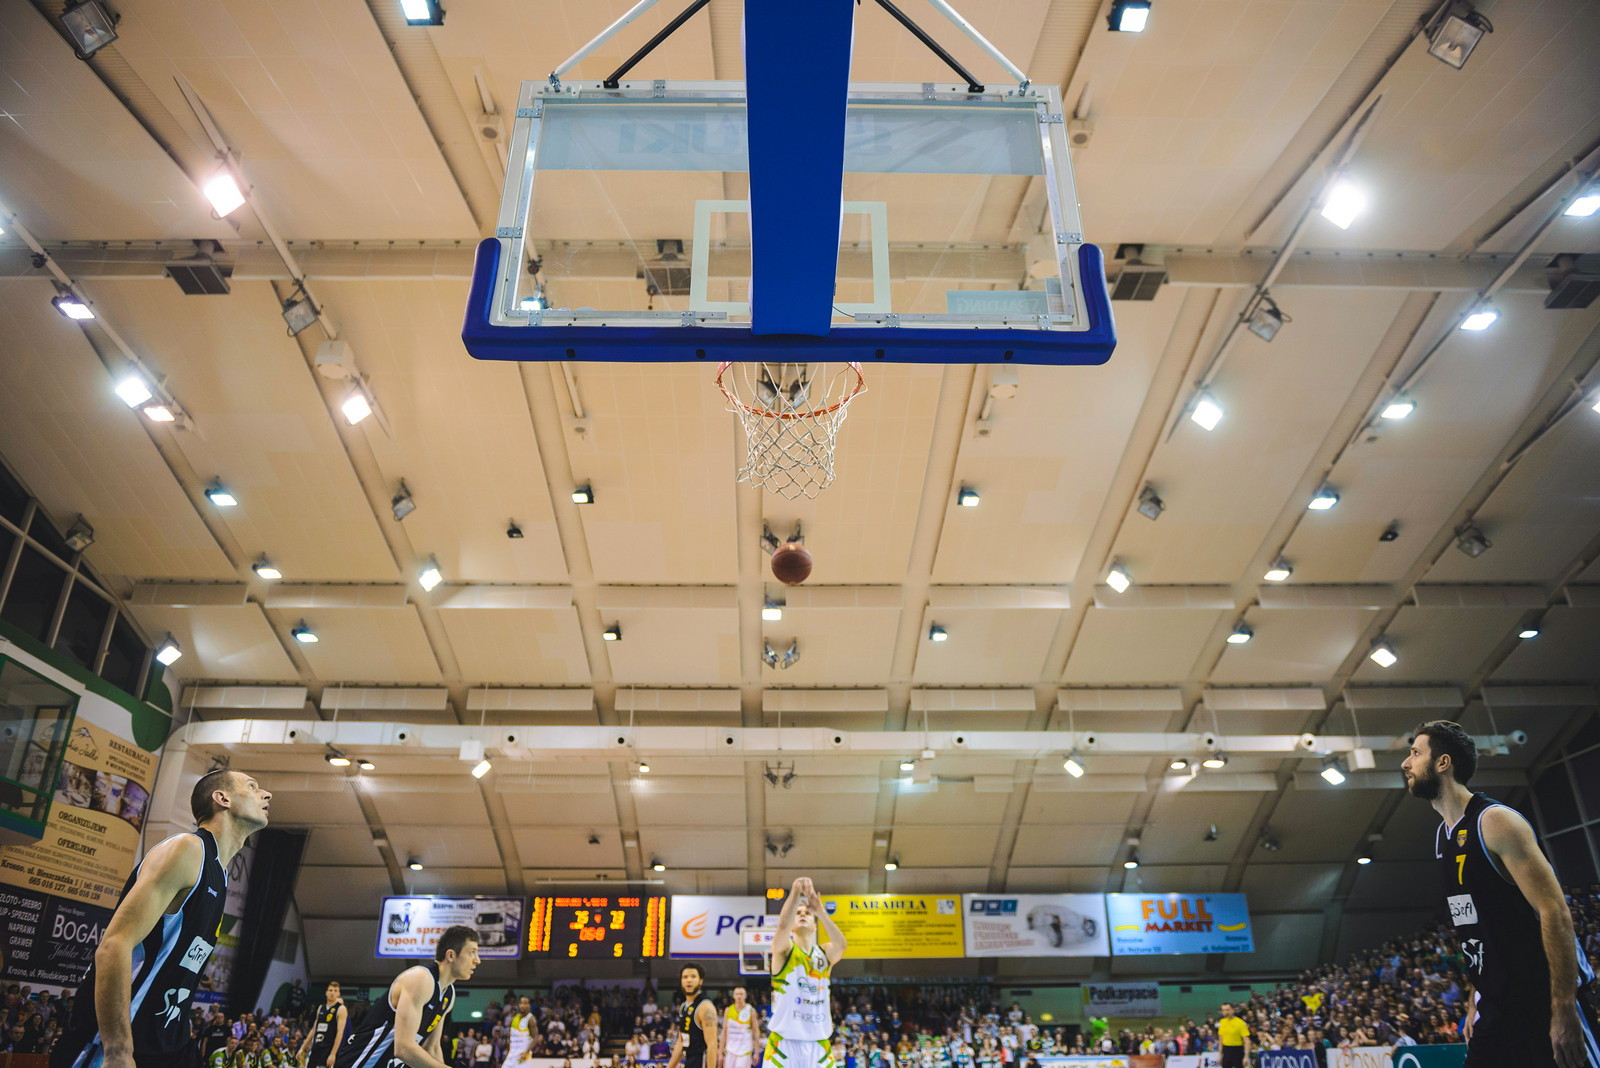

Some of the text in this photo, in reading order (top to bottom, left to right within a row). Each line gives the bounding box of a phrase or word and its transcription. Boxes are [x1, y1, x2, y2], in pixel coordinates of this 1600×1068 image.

[108, 739, 150, 765] RESTAURACJA
[58, 811, 107, 834] ORGANIZUJEMY
[57, 838, 97, 856] OFERUJEMY
[1455, 854, 1467, 885] 7
[21, 898, 42, 910] SREBRO
[1141, 899, 1213, 920] FULL
[8, 922, 35, 935] NAPRAWA
[1145, 921, 1214, 932] MARKET
[9, 936, 33, 947] GRAWER
[387, 937, 417, 946] opon
[11, 950, 30, 960] KOMIS
[7, 966, 28, 978] Krosno,
